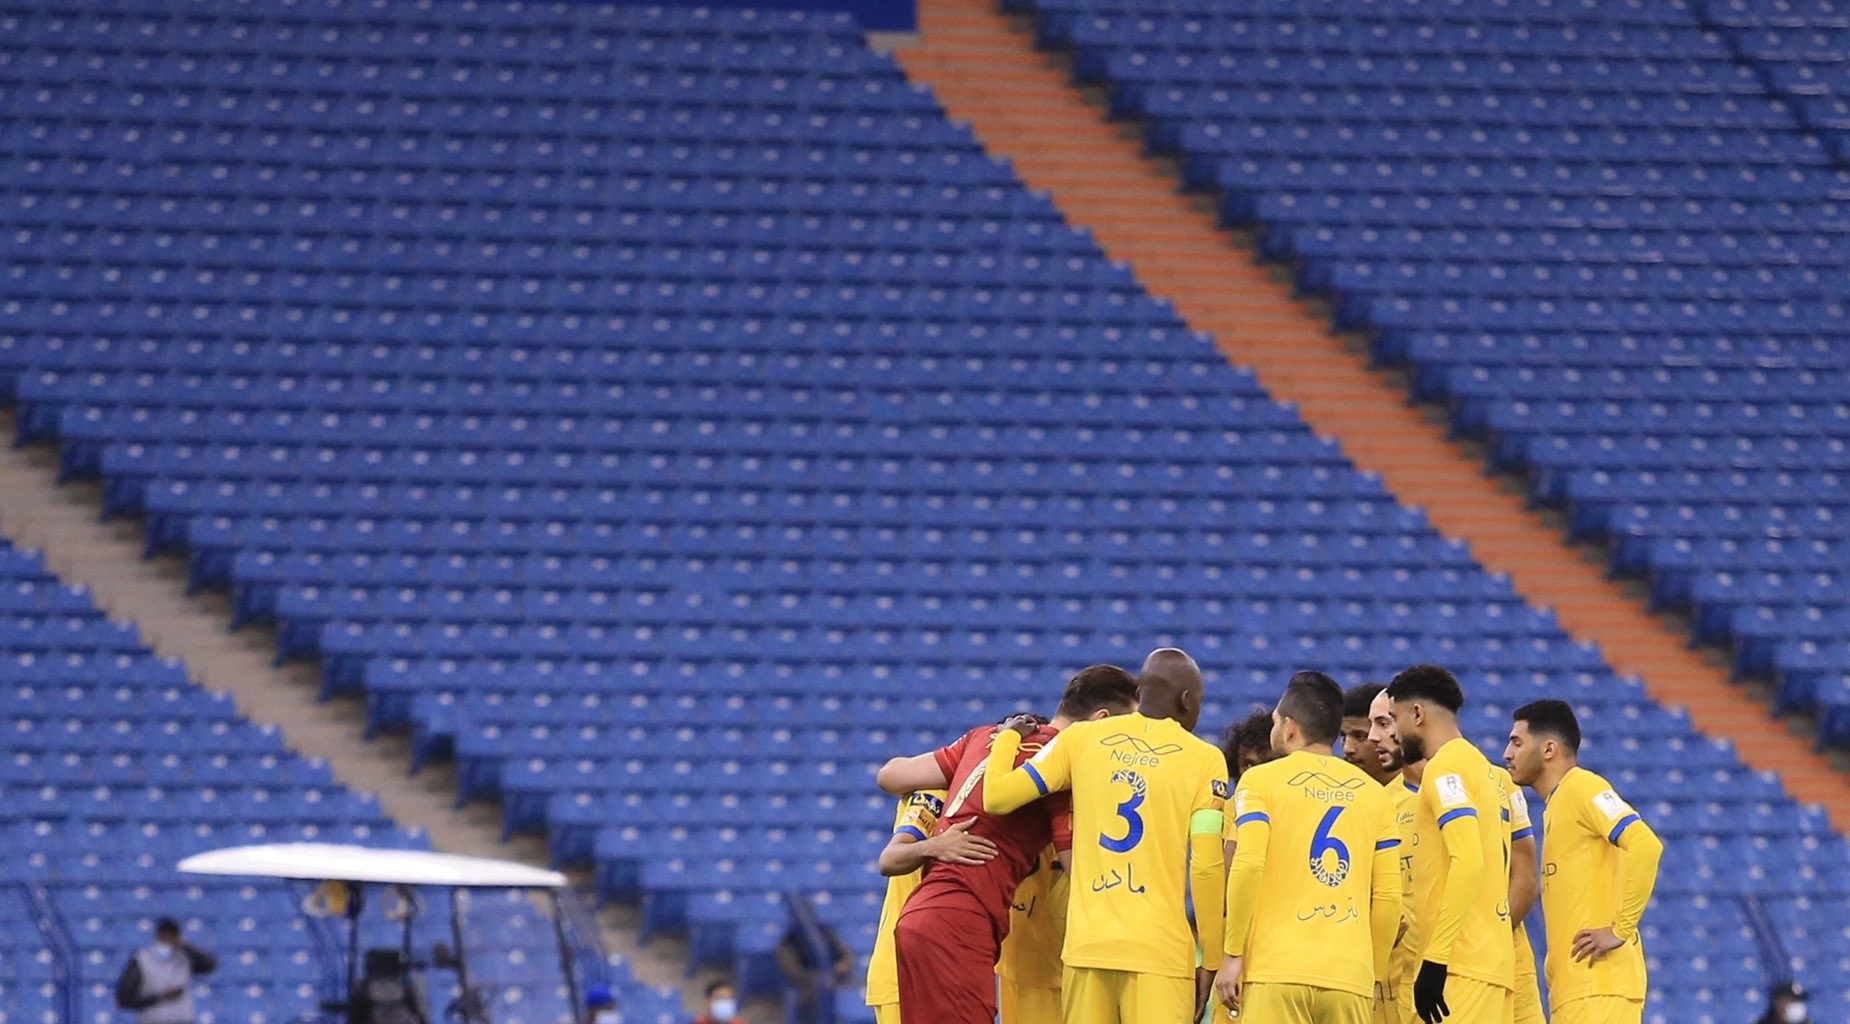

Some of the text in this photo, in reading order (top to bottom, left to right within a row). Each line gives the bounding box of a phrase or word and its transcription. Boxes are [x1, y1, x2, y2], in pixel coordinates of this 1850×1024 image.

[1110, 749, 1159, 767] Nejree
[1098, 769, 1146, 853] 3
[1304, 787, 1355, 803] Nejree
[1309, 805, 1351, 887] 6
